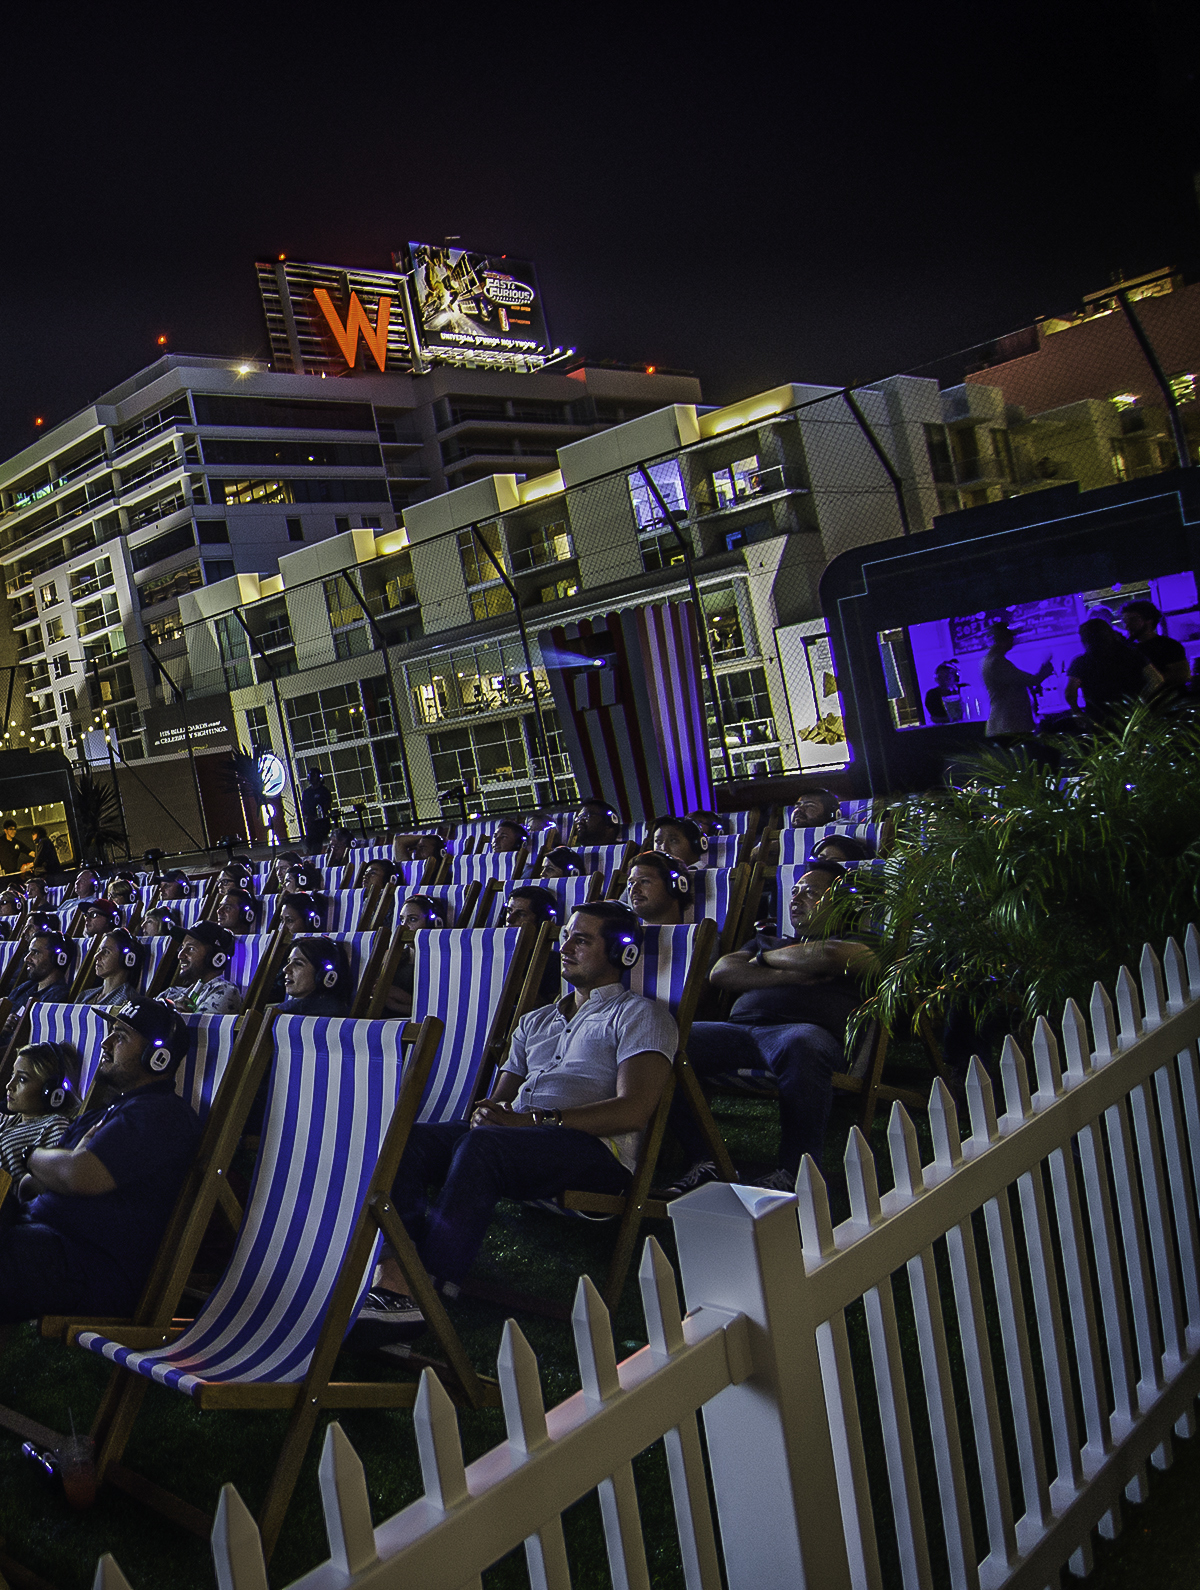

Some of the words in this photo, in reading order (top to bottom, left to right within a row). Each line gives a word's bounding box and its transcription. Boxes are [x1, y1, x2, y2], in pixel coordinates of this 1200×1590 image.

[486, 278, 511, 290] FAST
[490, 287, 530, 300] FURIOUS
[313, 288, 392, 373] W
